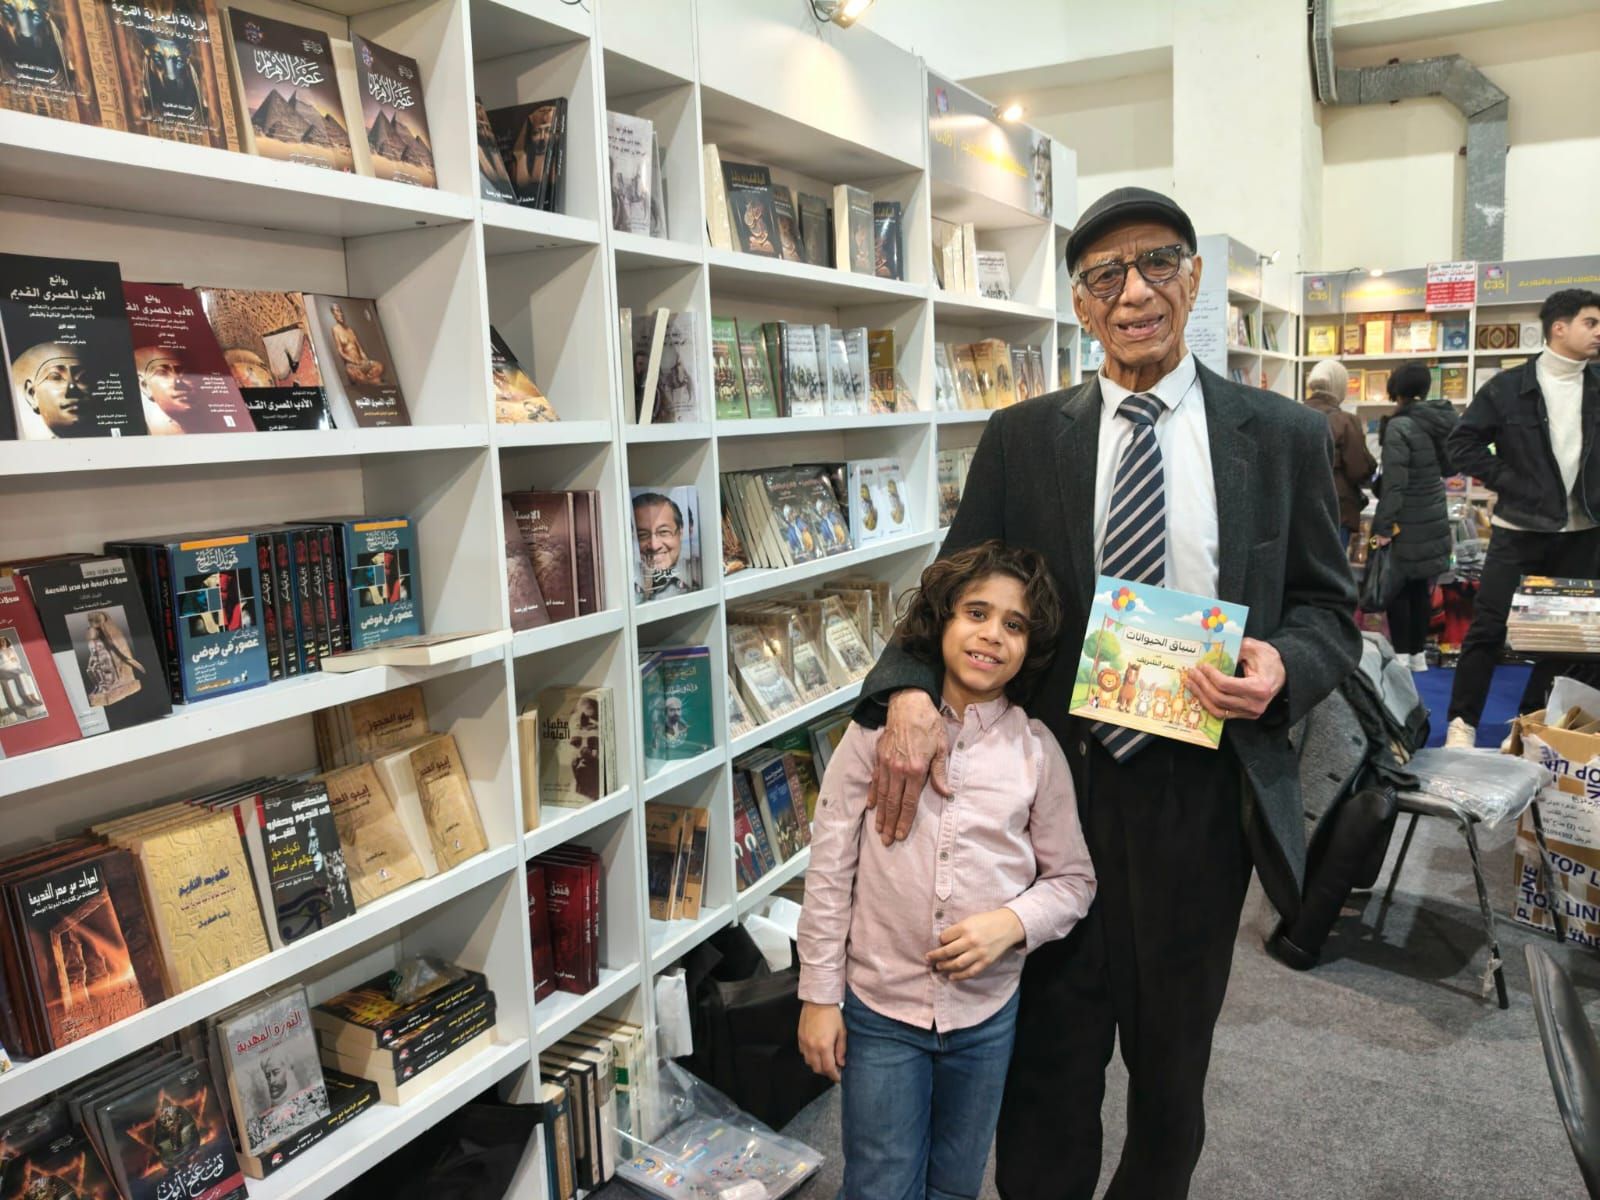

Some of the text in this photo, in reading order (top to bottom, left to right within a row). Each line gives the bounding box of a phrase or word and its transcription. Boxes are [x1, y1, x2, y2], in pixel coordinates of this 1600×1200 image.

[49, 274, 69, 287] روائع
[10, 286, 105, 302] الأدب المصرى القديم
[125, 302, 140, 312] الق
[174, 305, 194, 317] الأدب
[394, 609, 413, 622] عصور
[234, 639, 259, 655] عصور
[1126, 631, 1197, 654] سباق الحيوانات
[268, 826, 297, 844] القبور
[1549, 851, 1585, 876] TOP
[55, 885, 67, 900] مصر
[1565, 901, 1600, 922] LIN
[236, 1008, 304, 1055] الثورة المهدية
[200, 1153, 224, 1181] توت
